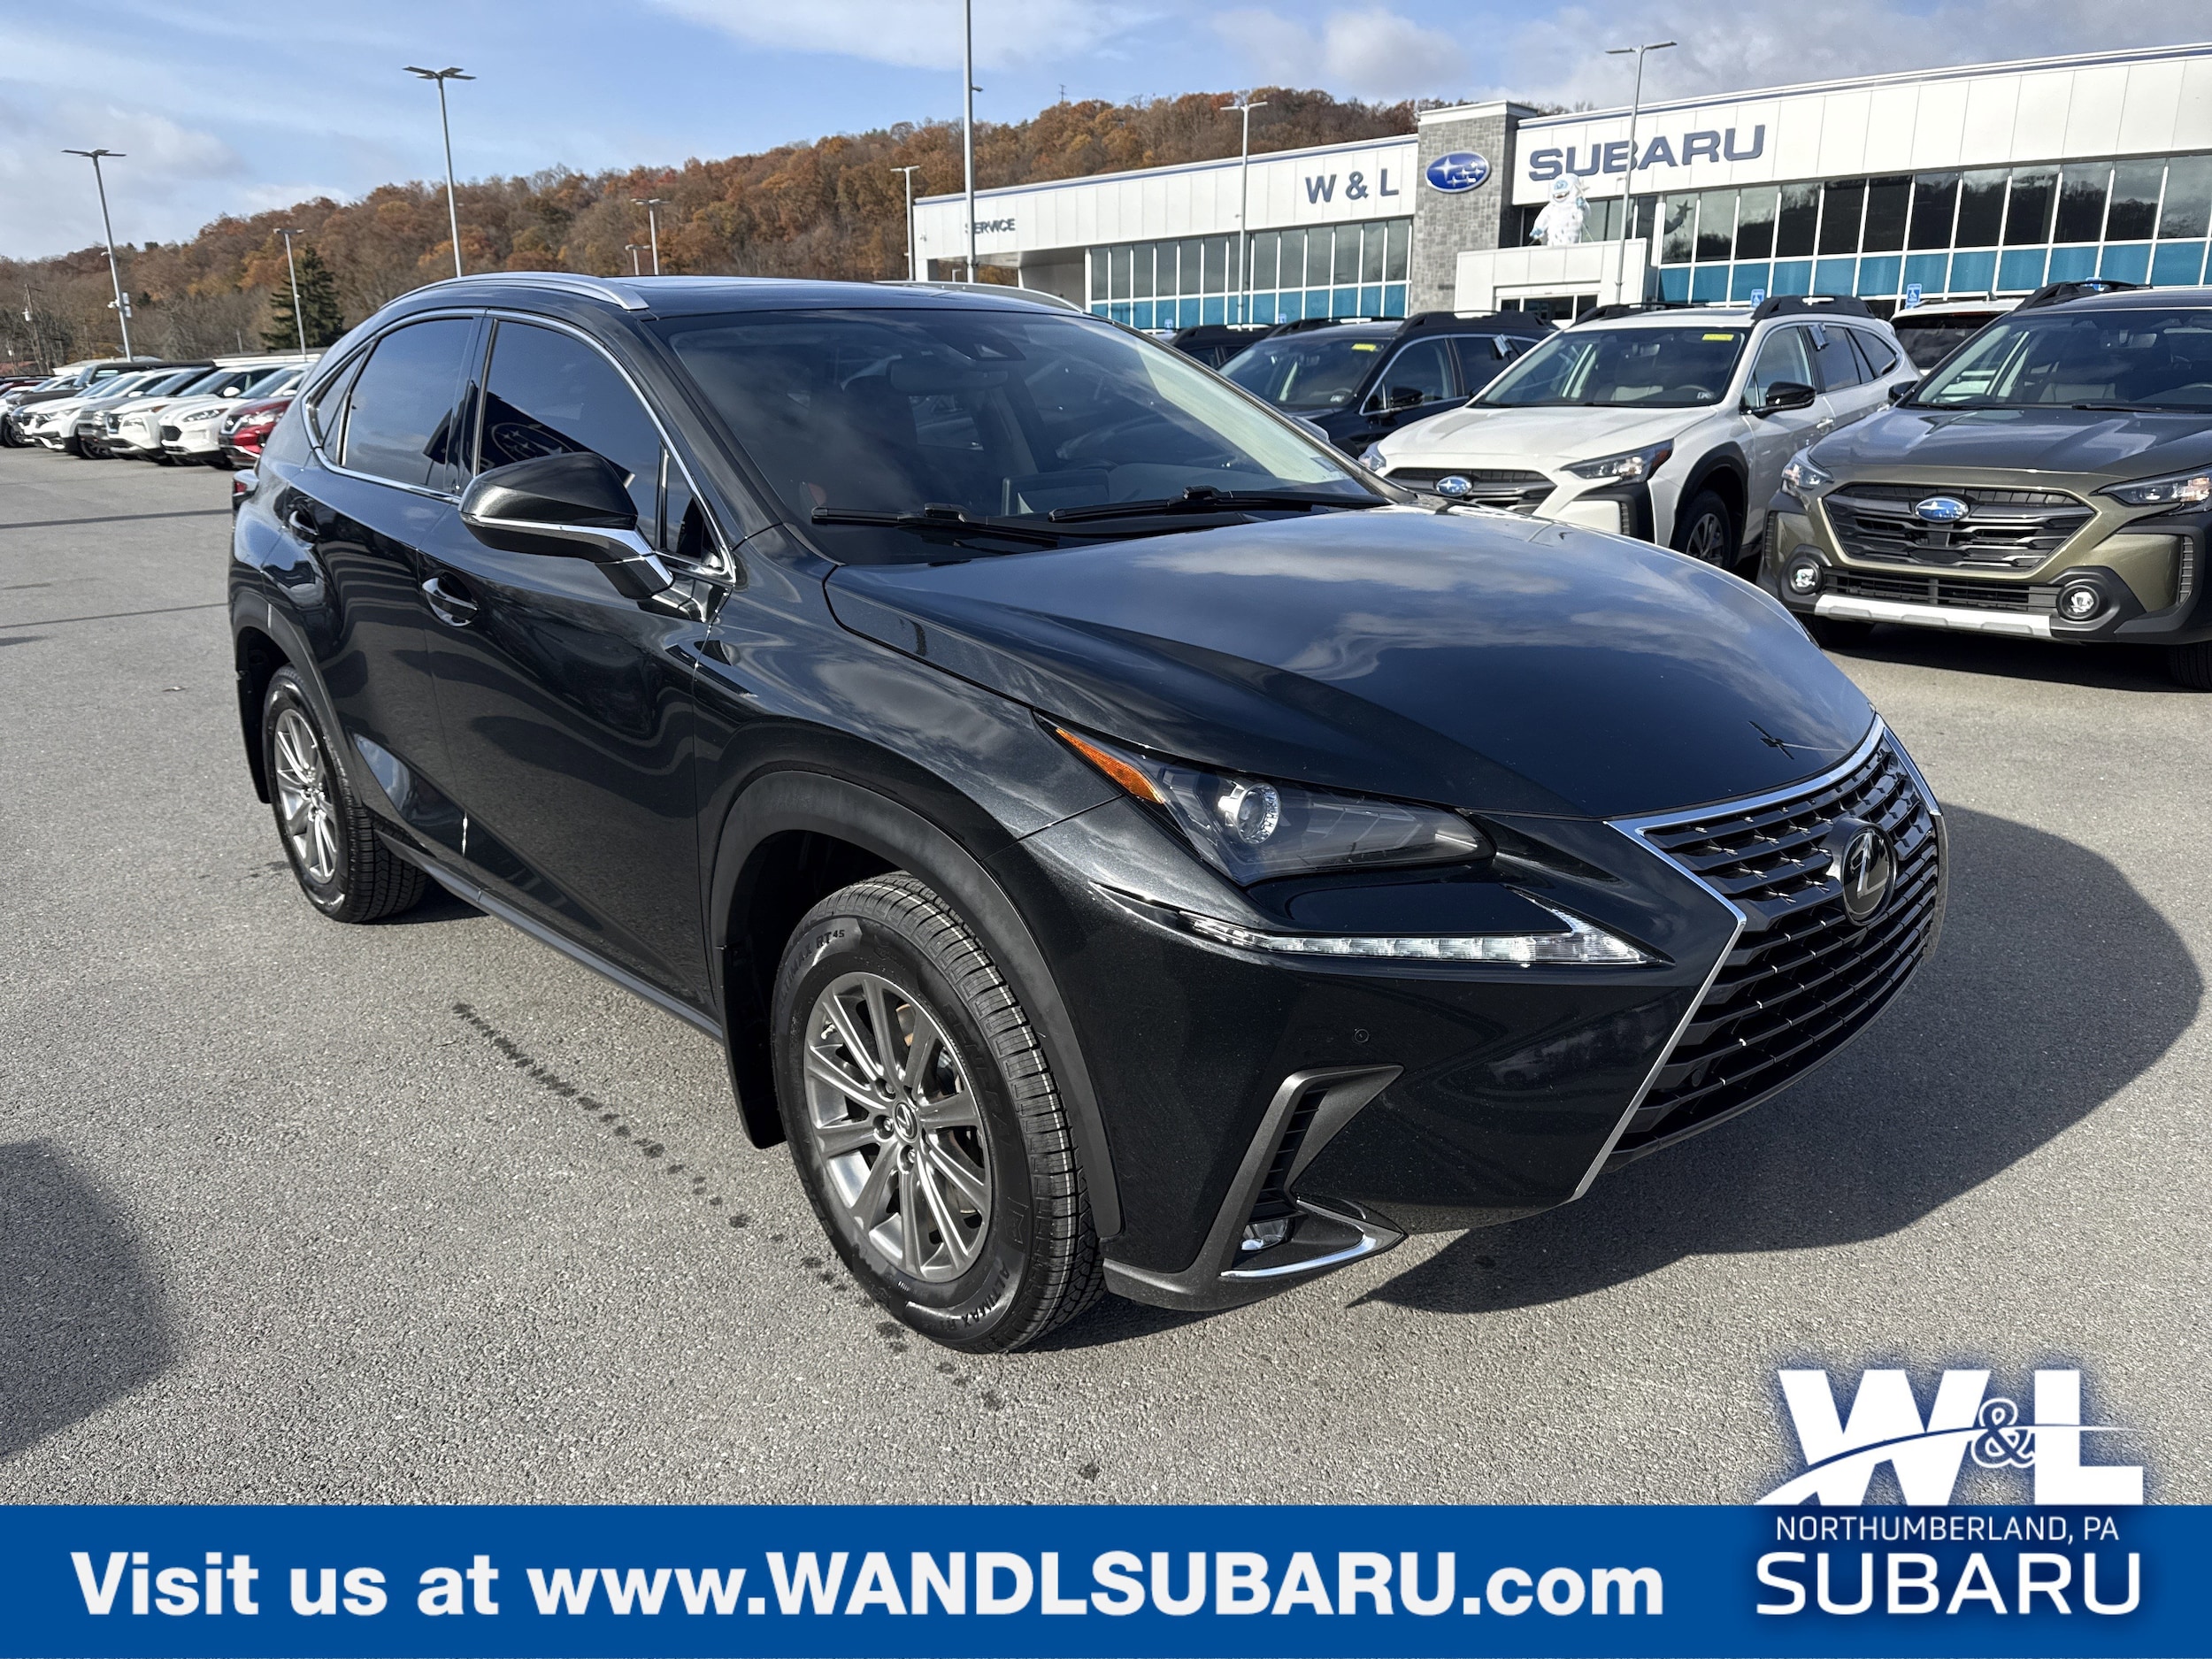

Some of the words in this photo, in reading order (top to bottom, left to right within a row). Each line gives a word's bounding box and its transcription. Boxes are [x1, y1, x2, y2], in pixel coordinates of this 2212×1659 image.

[1528, 124, 1766, 181] SUBARU
[1304, 173, 1338, 204] W
[1345, 171, 1369, 200] &
[1380, 167, 1399, 196] L
[961, 1261, 1010, 1328] ALTIMAX
